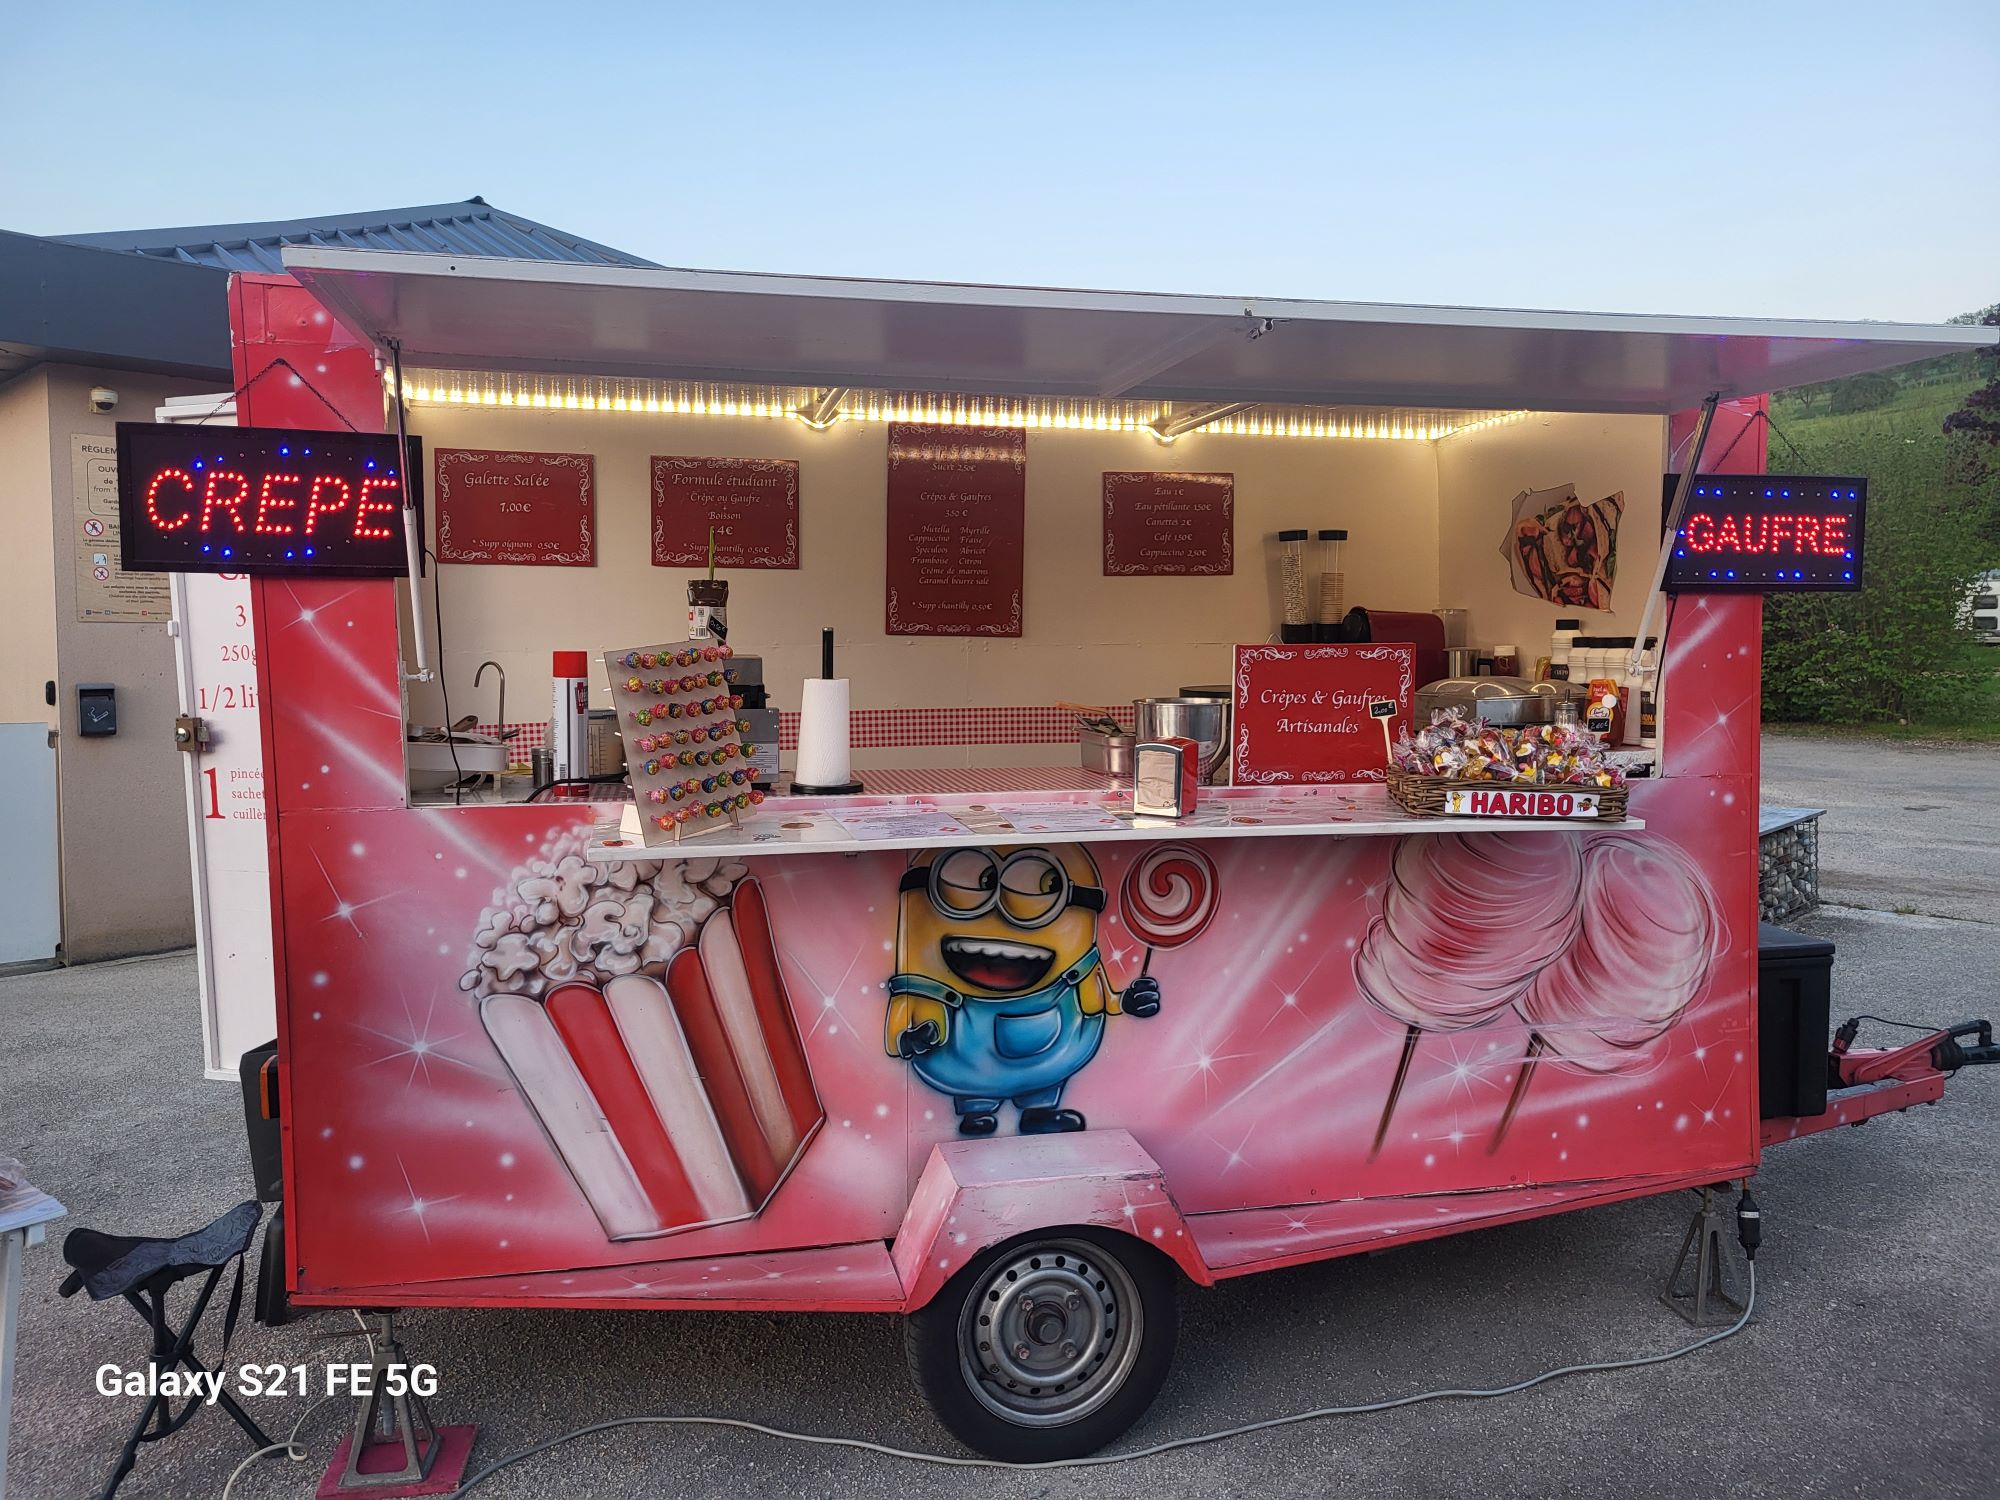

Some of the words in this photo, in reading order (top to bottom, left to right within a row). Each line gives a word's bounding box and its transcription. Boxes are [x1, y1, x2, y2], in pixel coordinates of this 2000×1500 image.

[464, 470, 510, 488] Galette
[513, 472, 550, 487] Salée
[671, 472, 722, 486] Formule
[726, 473, 778, 487] étudiant
[920, 492, 947, 504] Crêpes
[960, 491, 992, 505] Gaufres
[1154, 488, 1172, 496] Eau
[146, 468, 399, 537] CREPE
[690, 492, 715, 505] Crêpe
[730, 493, 761, 506] Gaufre
[1134, 502, 1152, 511] Eau
[1152, 501, 1191, 513] pétillante
[708, 511, 742, 520] Boisson
[1146, 518, 1179, 526] Canettes
[716, 526, 734, 536] 4€
[921, 524, 950, 534] Nutella
[960, 526, 991, 536] Myrtille
[1685, 511, 1848, 555] GAUFRE
[908, 534, 950, 544] Cappuccino
[960, 536, 983, 544] Fraise
[1154, 532, 1172, 544] Café
[478, 539, 500, 550] Supp
[502, 540, 533, 551] oignons
[688, 542, 709, 554] Supp
[713, 543, 744, 554] hantilly
[915, 545, 948, 556] Speculoos
[960, 546, 986, 555] Abricot
[1140, 548, 1185, 560] Cappuccino
[910, 556, 949, 565] Framboise
[958, 557, 982, 565] Citron
[946, 566, 955, 575] de
[918, 576, 949, 584] Caramel
[951, 576, 974, 585] beurre
[917, 602, 937, 612] Supp
[938, 602, 970, 612] chantilly
[234, 604, 246, 628] 3
[199, 684, 236, 712] 1/2
[240, 684, 260, 708] li
[1260, 689, 1308, 710] Crêpes
[1311, 690, 1328, 704] &
[1332, 688, 1388, 712] Gaufres
[1276, 716, 1360, 734] Artisanales
[203, 767, 226, 819] 1
[1470, 791, 1574, 816] HARIBO
